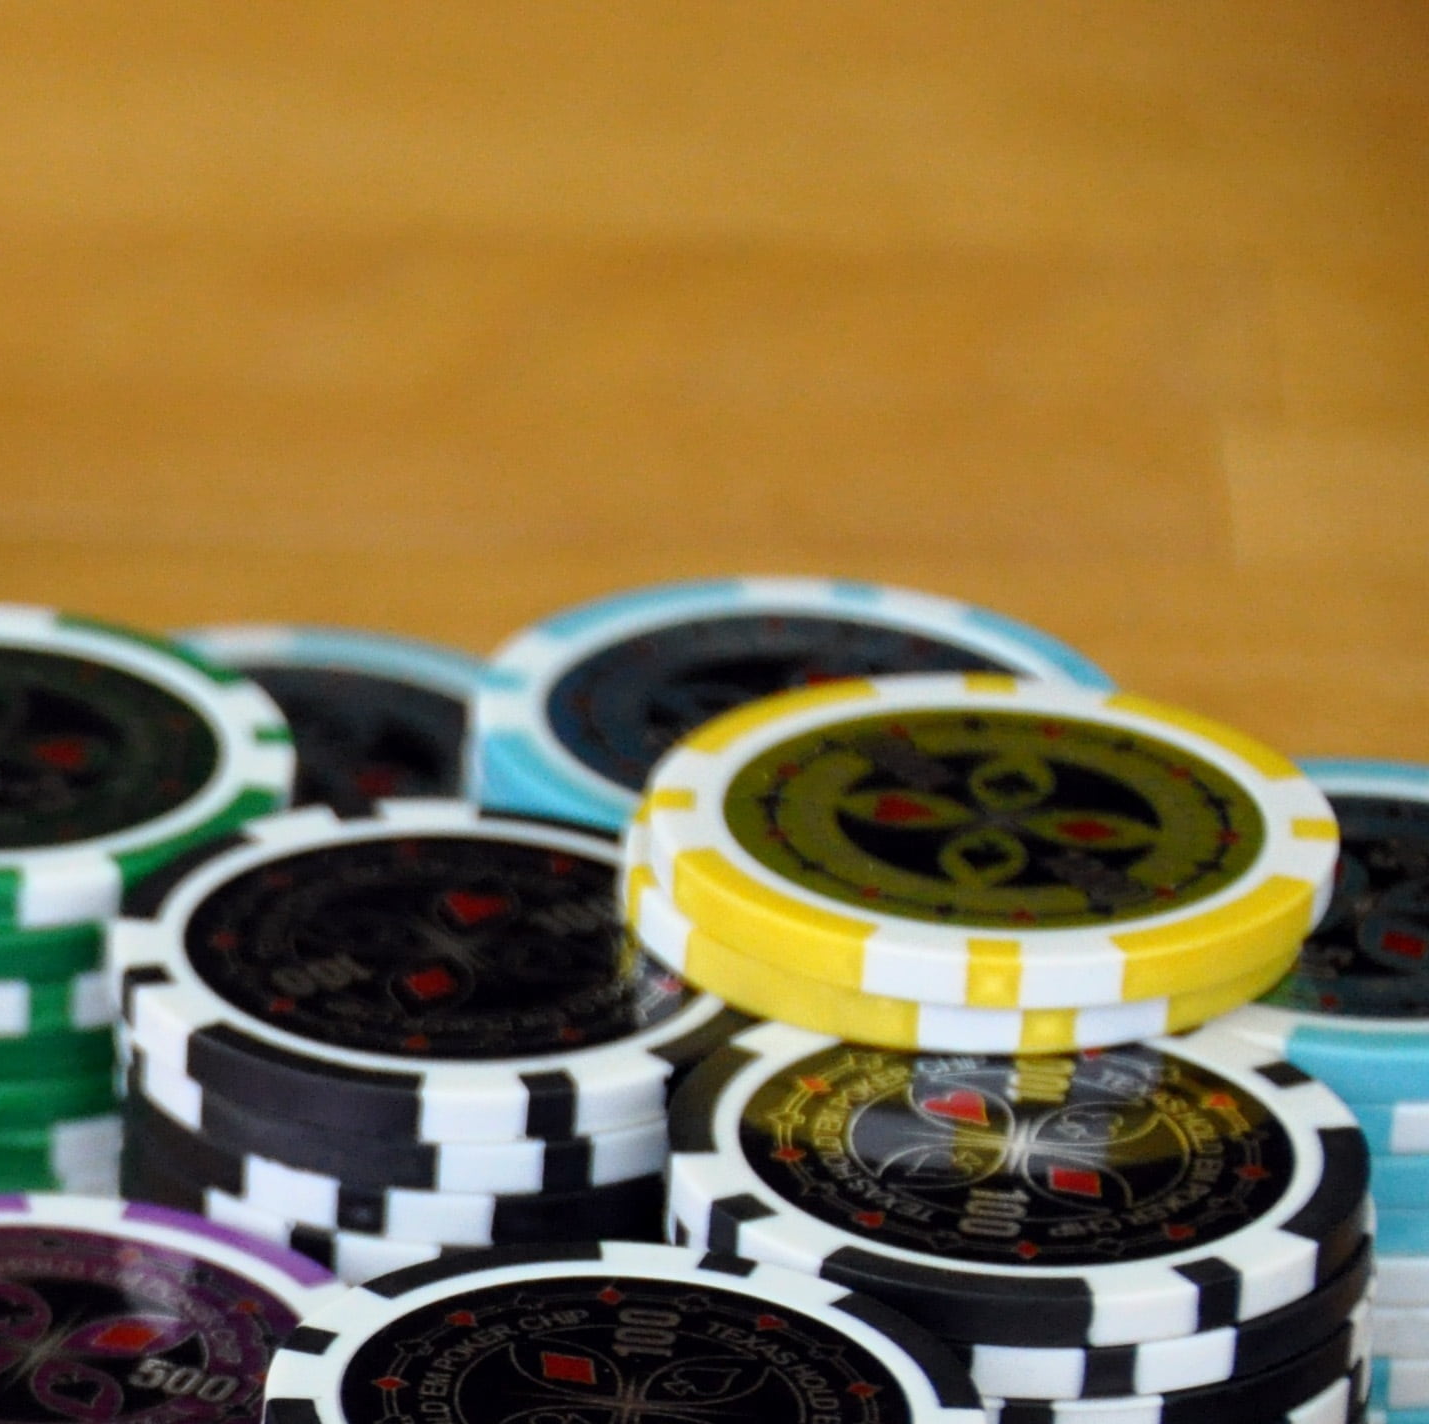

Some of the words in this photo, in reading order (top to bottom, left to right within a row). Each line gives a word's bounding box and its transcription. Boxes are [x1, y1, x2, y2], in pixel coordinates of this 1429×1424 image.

[956, 1187, 1032, 1239] 100
[440, 1323, 521, 1373] POKER
[518, 1308, 590, 1331] CHIP
[611, 1308, 682, 1358] 100
[706, 1320, 798, 1366] TEXAS
[125, 1355, 240, 1402] 500
